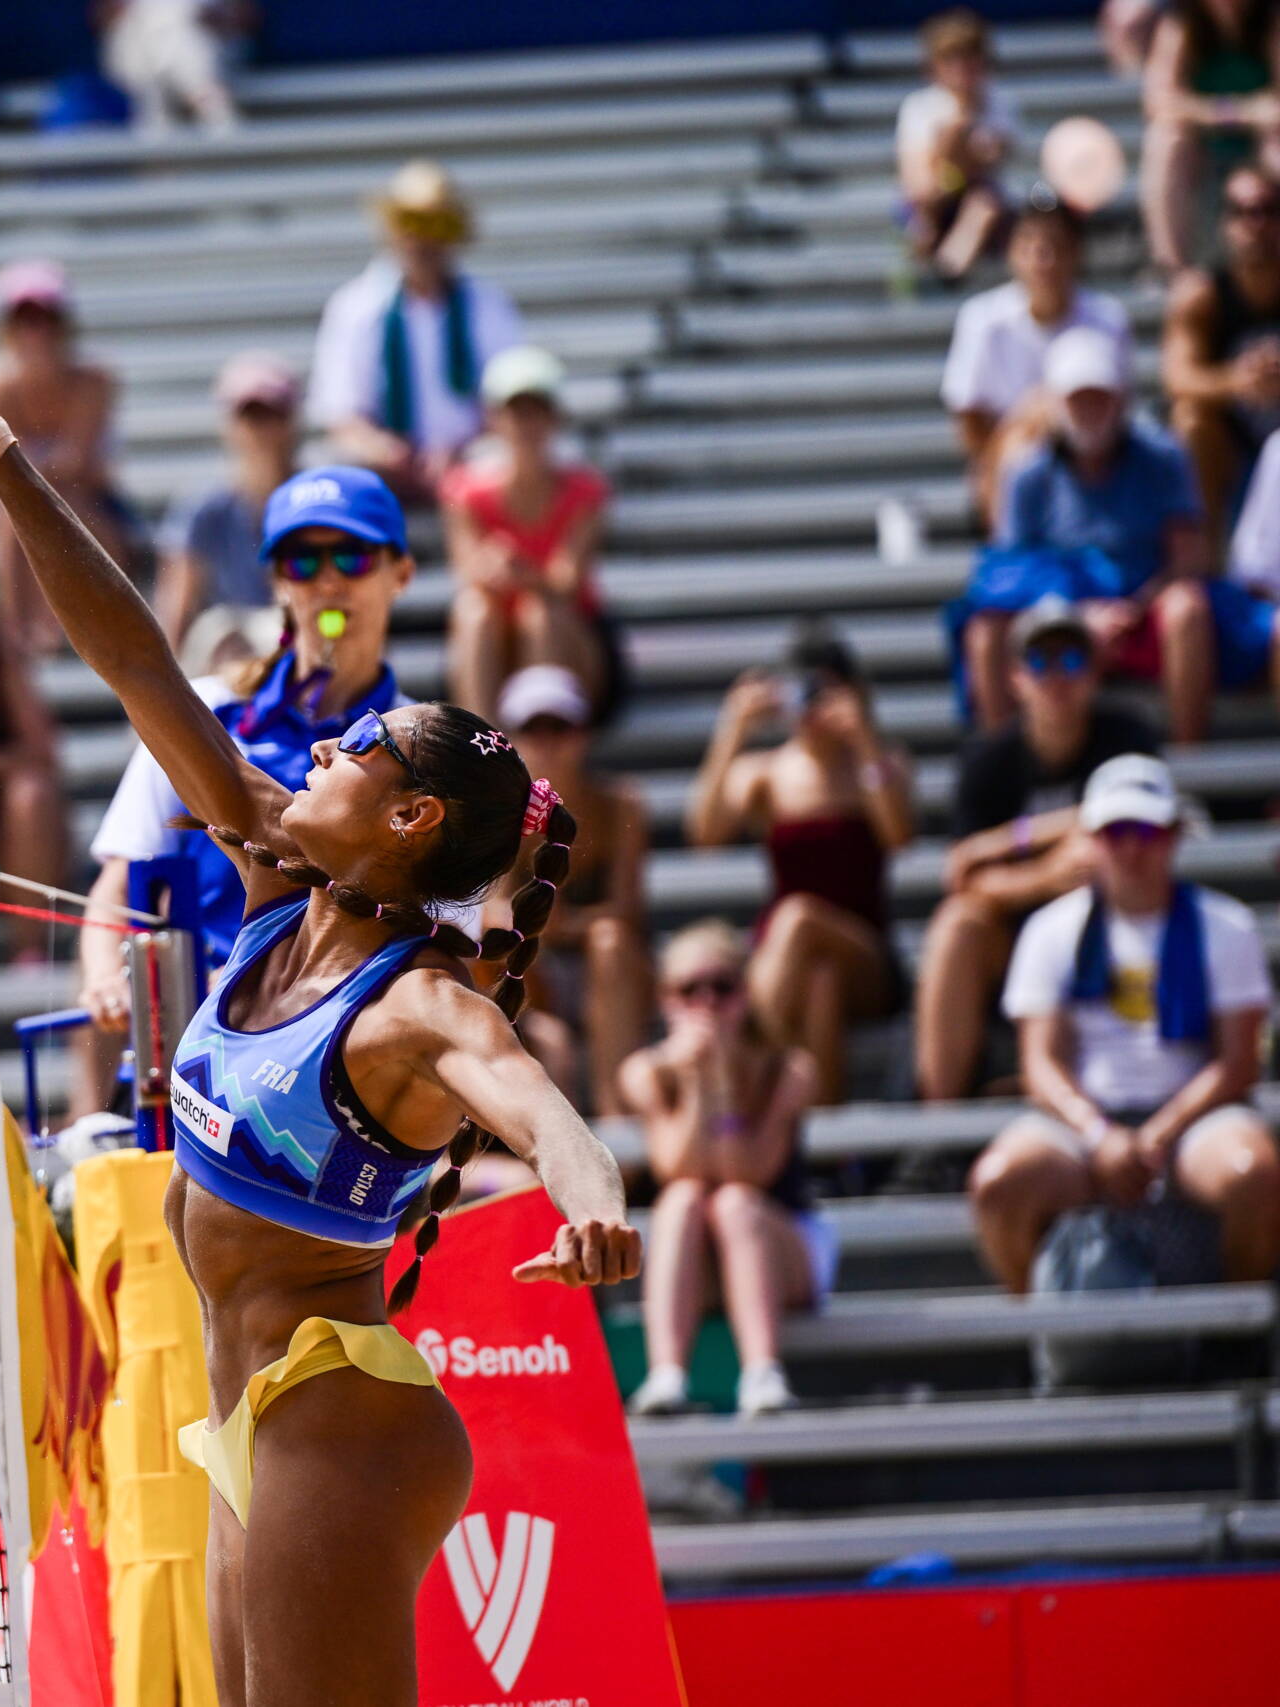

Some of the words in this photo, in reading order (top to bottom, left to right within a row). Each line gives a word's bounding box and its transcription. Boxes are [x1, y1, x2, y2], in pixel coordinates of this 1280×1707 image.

[250, 1059, 299, 1094] FRA
[349, 1163, 378, 1206] GSTAAD
[449, 1334, 570, 1378] Senoh
